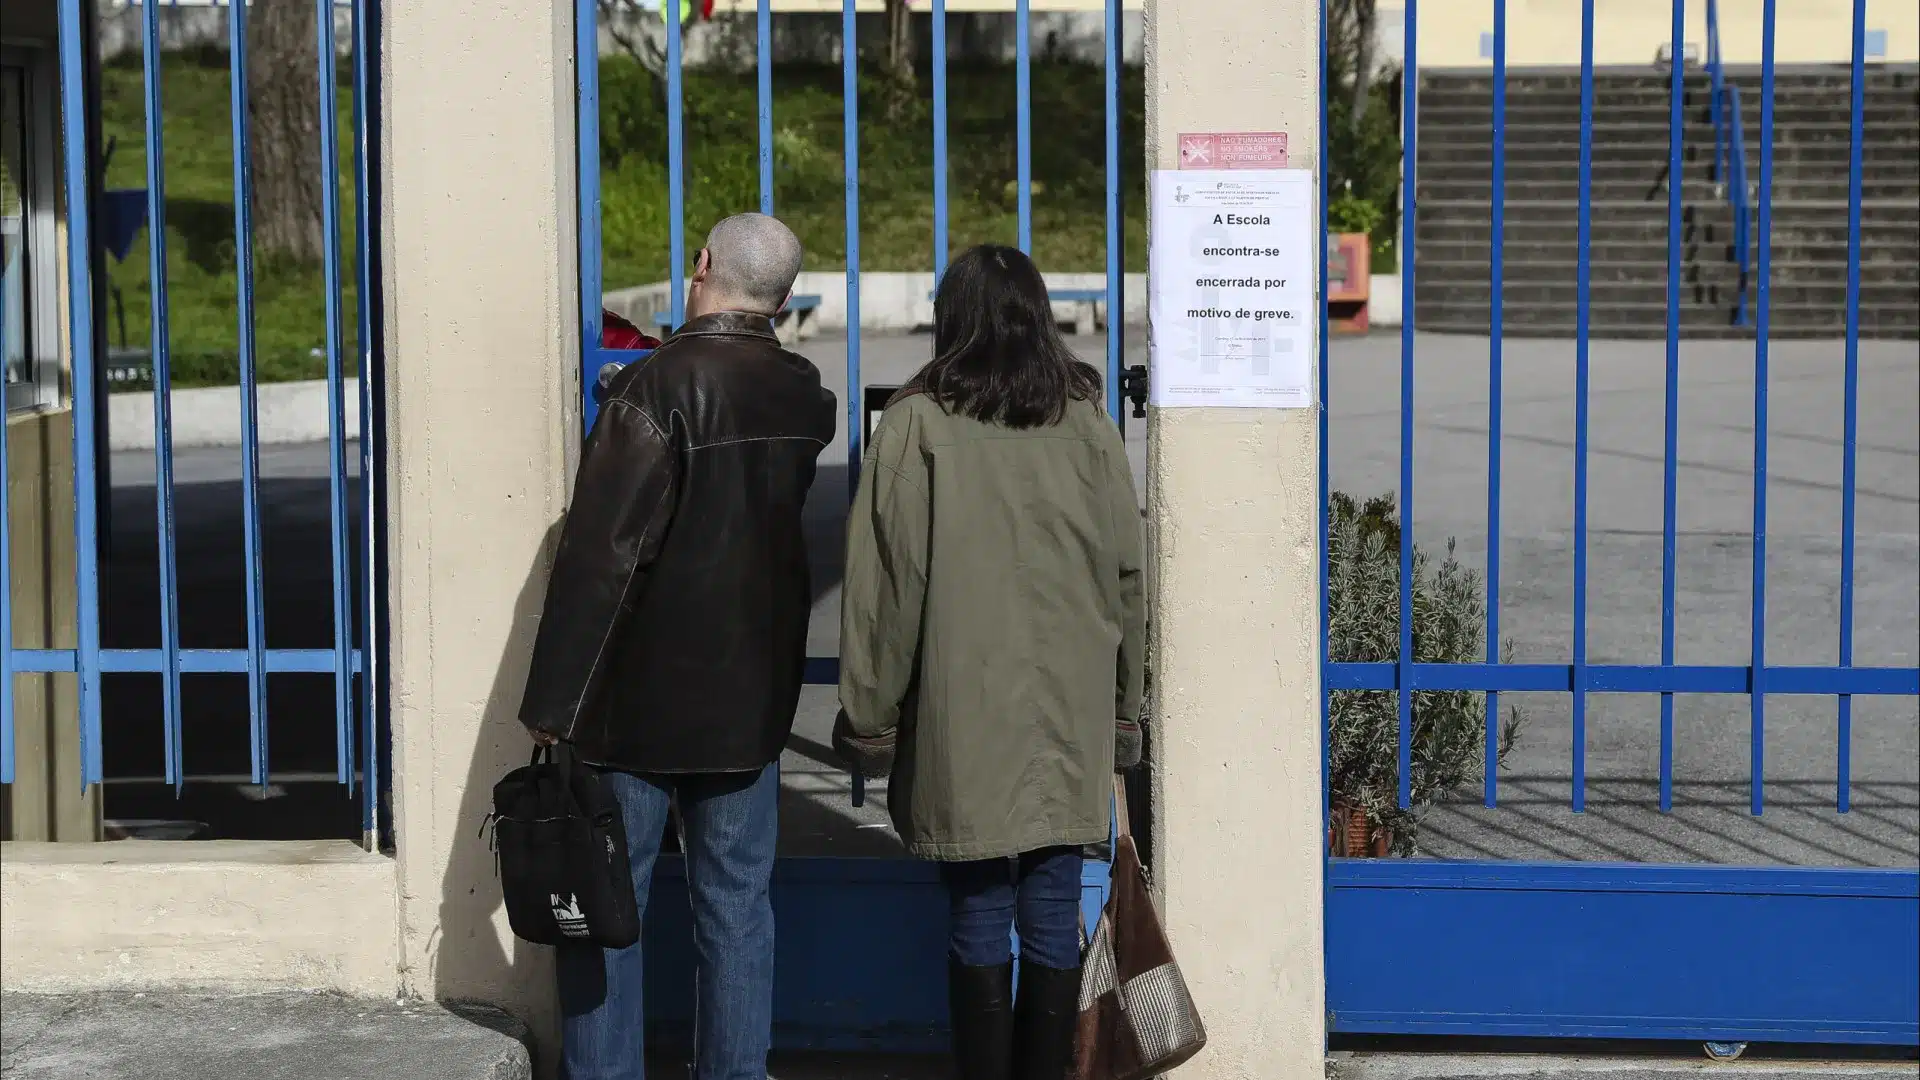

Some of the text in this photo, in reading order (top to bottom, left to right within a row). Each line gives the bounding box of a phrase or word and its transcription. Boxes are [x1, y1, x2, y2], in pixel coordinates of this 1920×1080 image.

[1234, 145, 1268, 153] SMOKERS
[1213, 214, 1270, 225] A Escola
[1203, 246, 1280, 256] encontra-se
[1196, 277, 1286, 291] encerrada por
[1187, 308, 1294, 321] motivo de greve.
